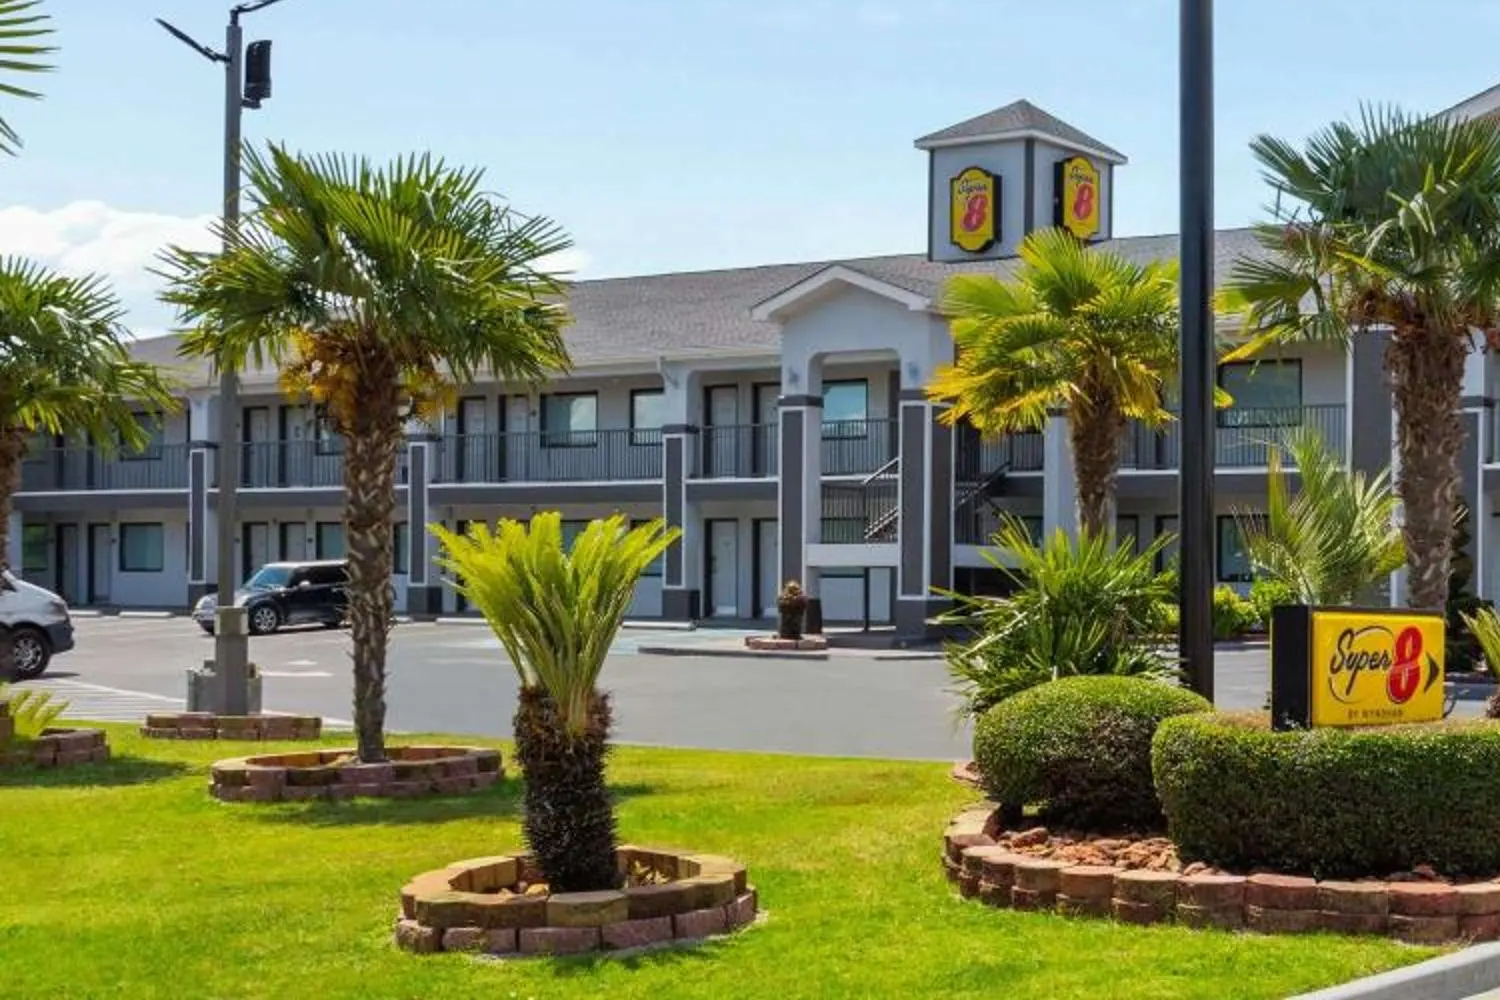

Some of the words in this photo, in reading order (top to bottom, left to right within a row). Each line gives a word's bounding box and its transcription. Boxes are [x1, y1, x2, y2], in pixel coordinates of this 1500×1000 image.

[962, 195, 987, 232] 8
[1330, 627, 1392, 696] Super
[1387, 625, 1423, 704] 8
